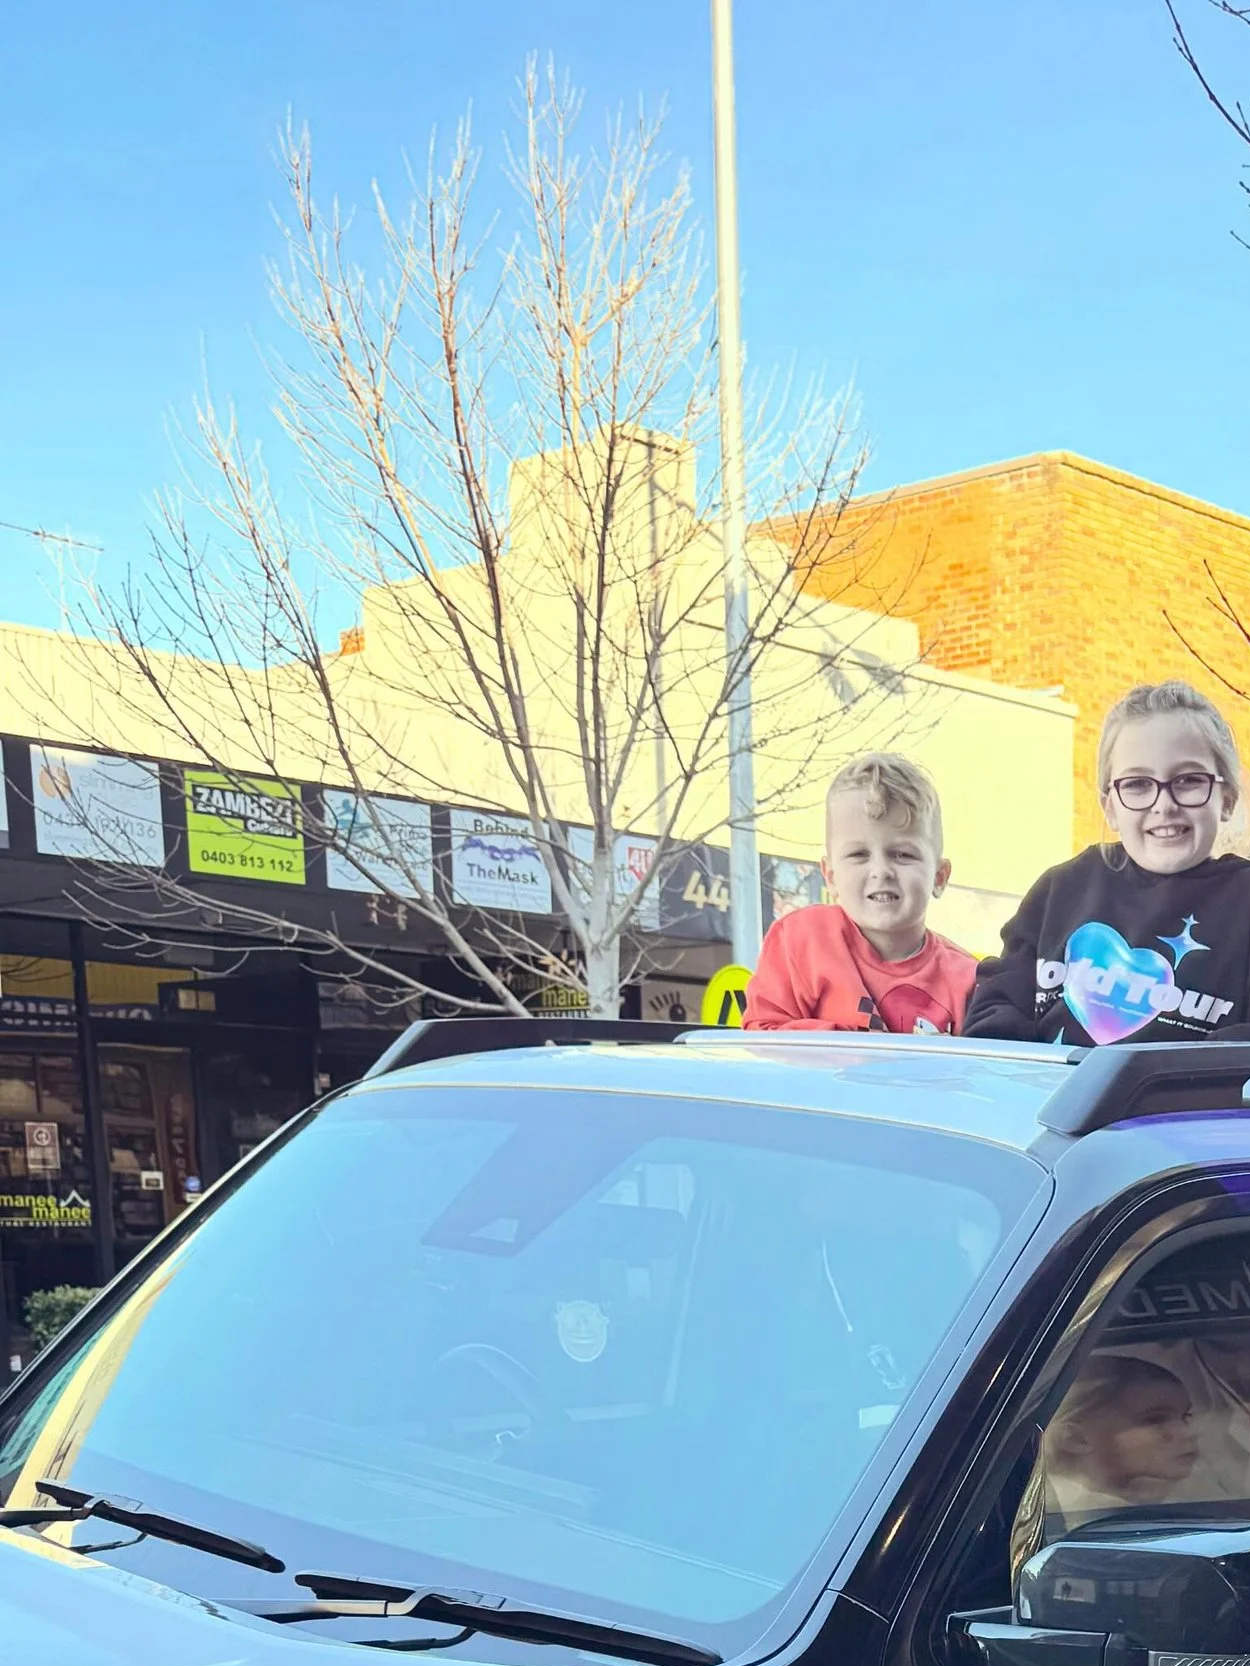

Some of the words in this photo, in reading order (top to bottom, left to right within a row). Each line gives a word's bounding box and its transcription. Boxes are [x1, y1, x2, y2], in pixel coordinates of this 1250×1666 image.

[473, 818, 529, 839] Behind
[201, 849, 235, 866] 0403
[240, 854, 265, 869] 813
[270, 857, 294, 873] 112
[1121, 968, 1235, 1024] Tour
[32, 1206, 91, 1220] manee
